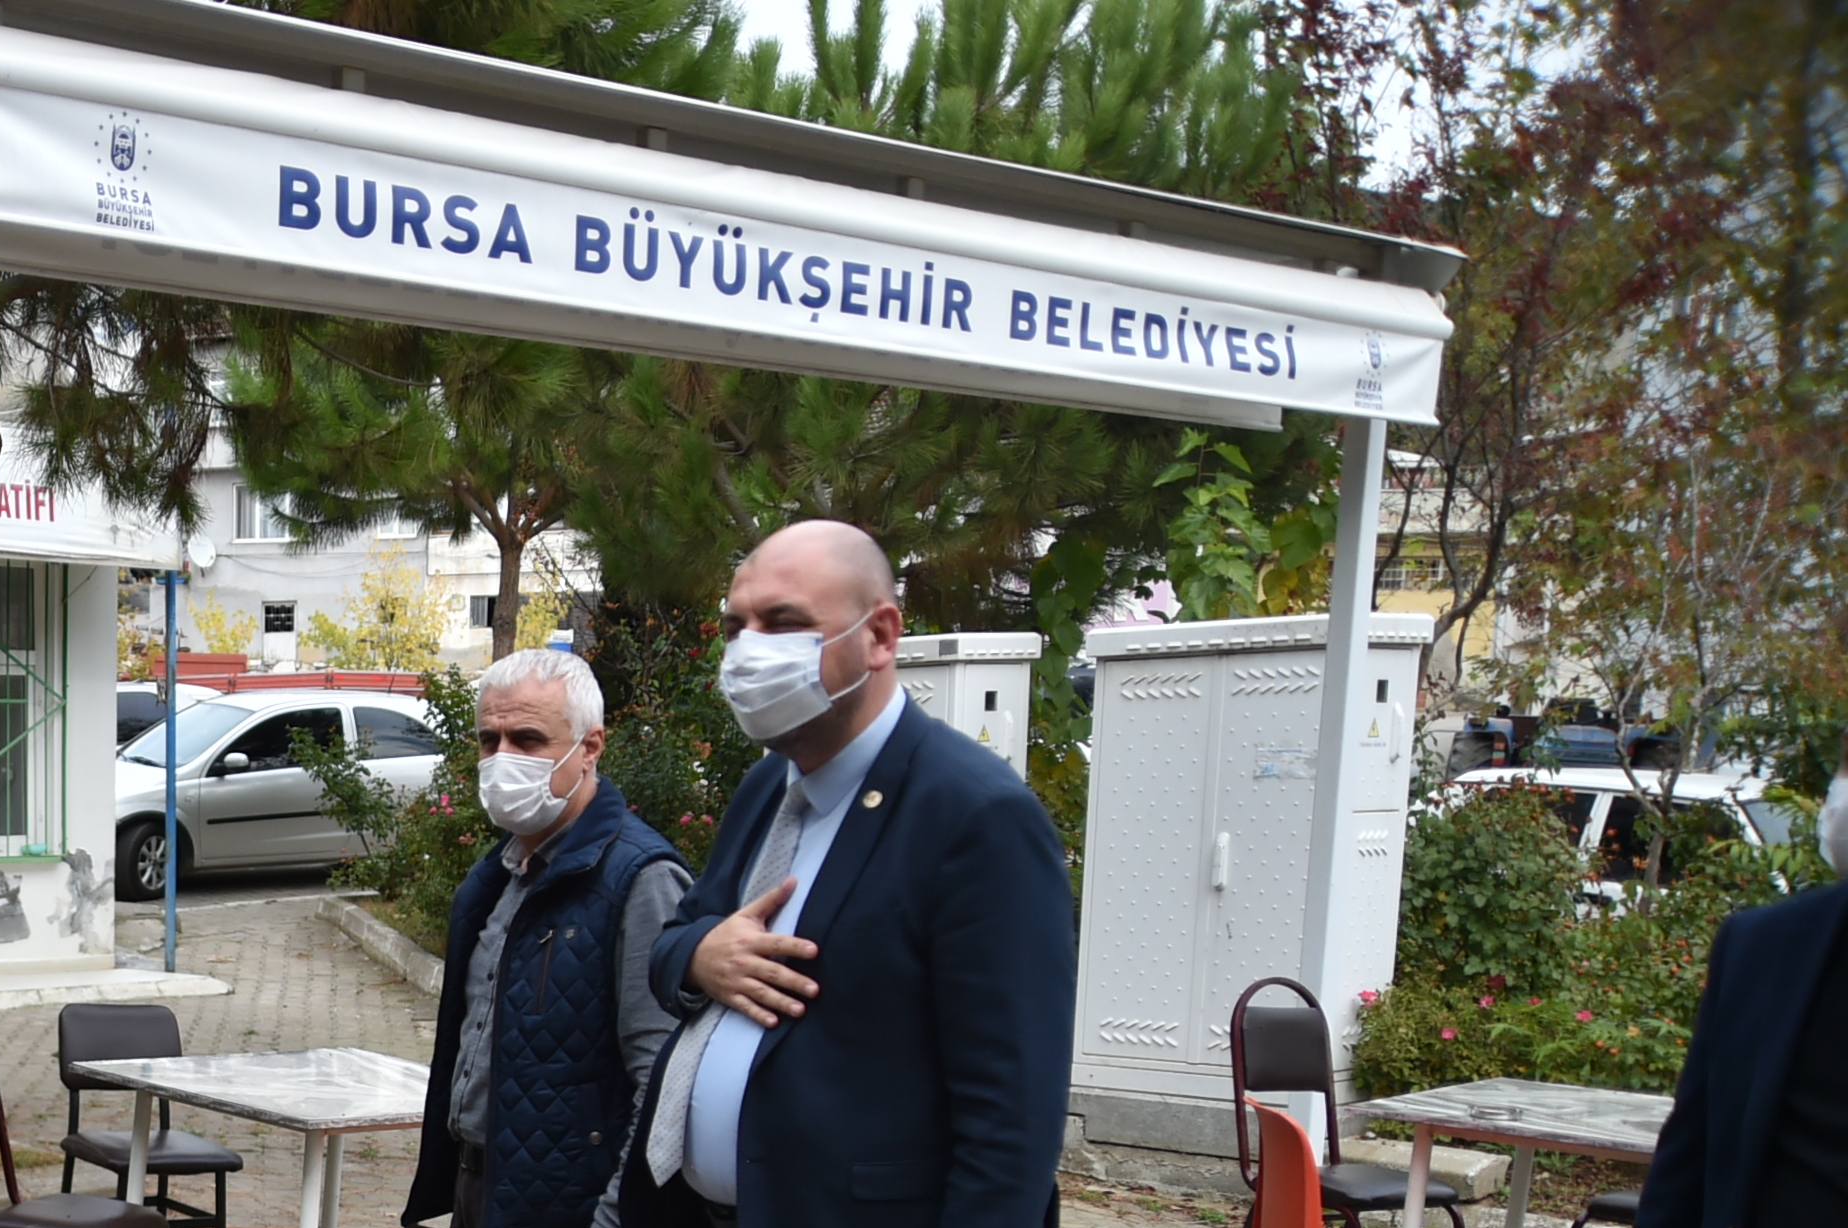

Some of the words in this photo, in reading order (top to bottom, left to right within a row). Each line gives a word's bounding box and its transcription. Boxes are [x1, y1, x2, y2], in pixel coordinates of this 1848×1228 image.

[95, 181, 152, 206] BURSA
[97, 198, 153, 217] BÜYÜKŞEHİR
[95, 212, 155, 232] BELEDİYESİ
[279, 164, 533, 265] BURSA
[574, 206, 973, 332] BÜYÜKŞEHİR
[1009, 289, 1298, 380] BELEDİYESİ
